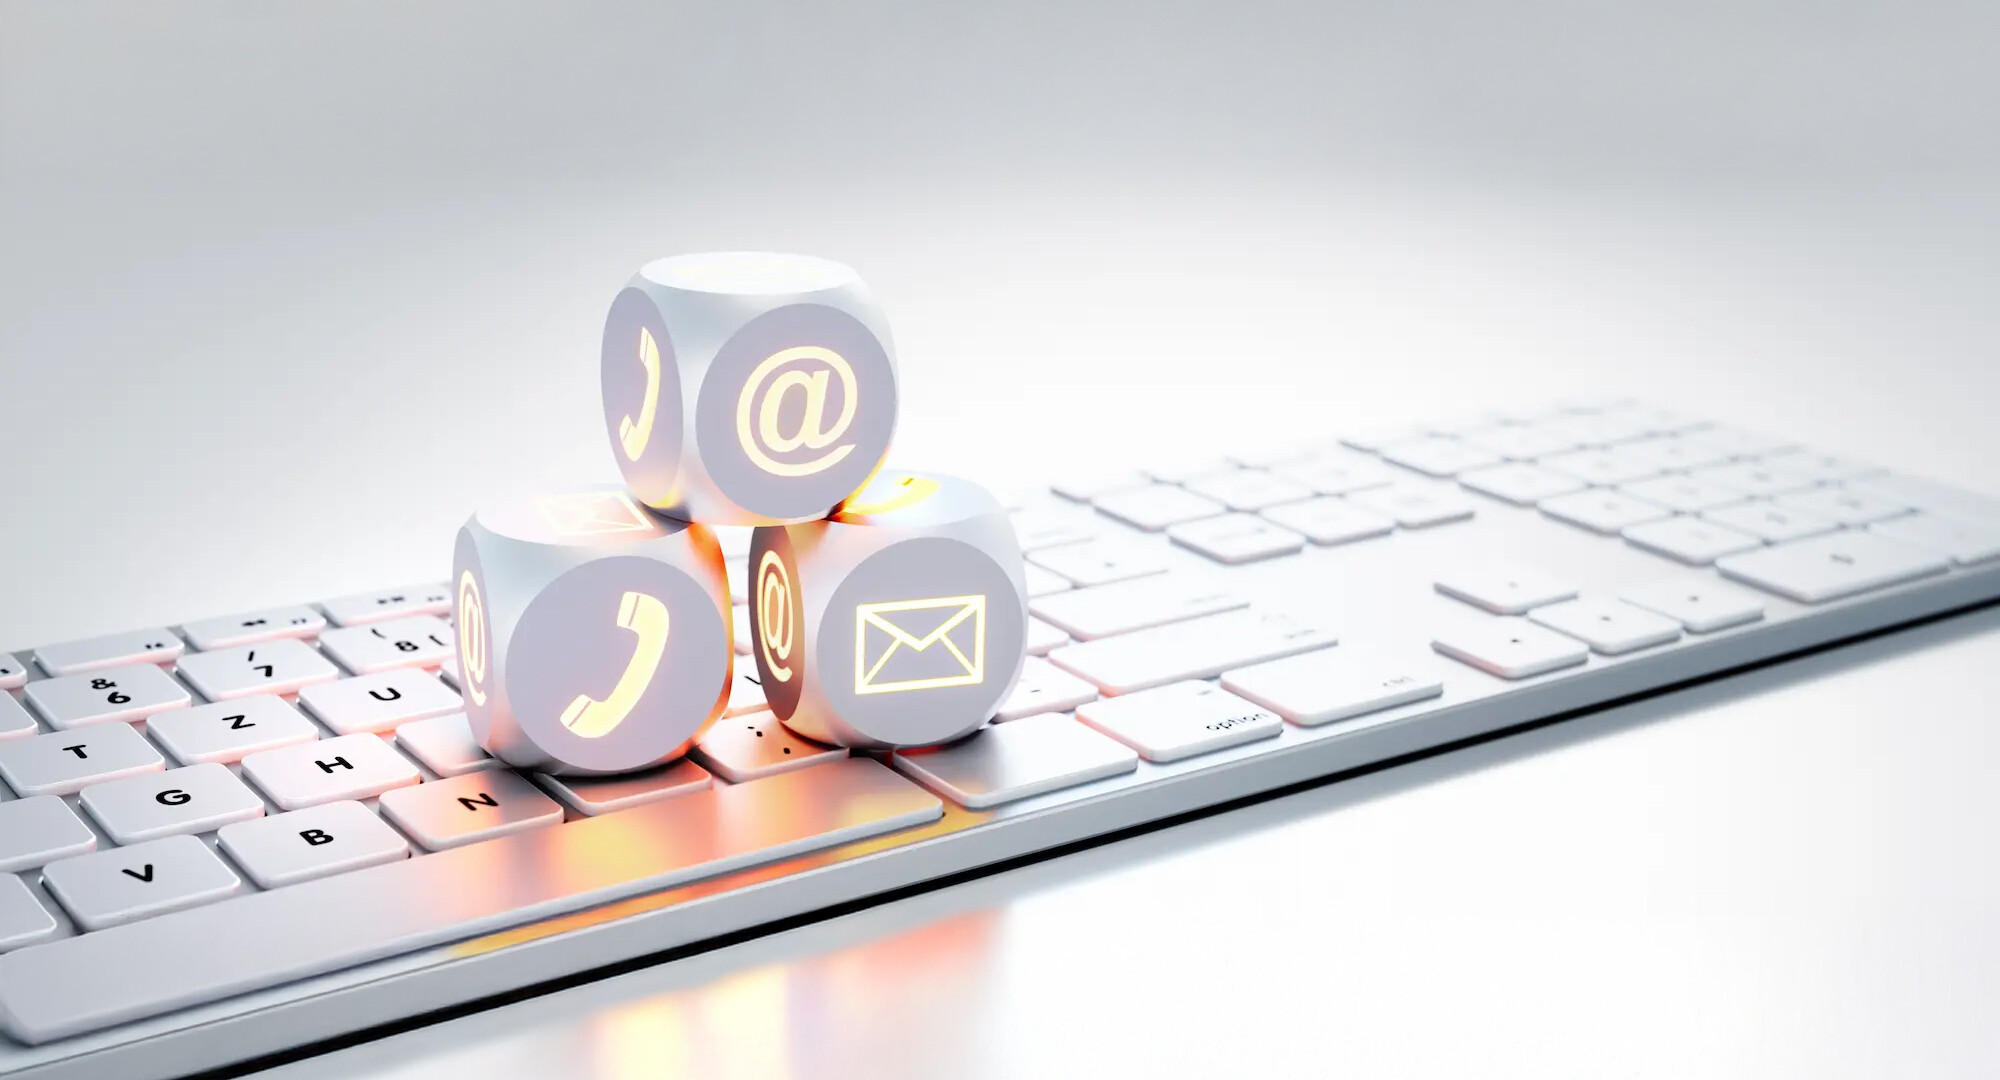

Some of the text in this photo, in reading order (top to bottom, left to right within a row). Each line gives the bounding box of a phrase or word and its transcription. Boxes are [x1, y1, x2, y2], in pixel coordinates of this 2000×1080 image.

[90, 678, 117, 690] &
[107, 691, 132, 704] 6
[368, 687, 402, 702] U
[221, 714, 256, 730] Z
[1206, 711, 1268, 730] option
[62, 744, 88, 760] T
[314, 756, 354, 774] H
[155, 788, 192, 806] G
[457, 792, 499, 812] N
[298, 828, 334, 846] B
[121, 863, 154, 883] V
